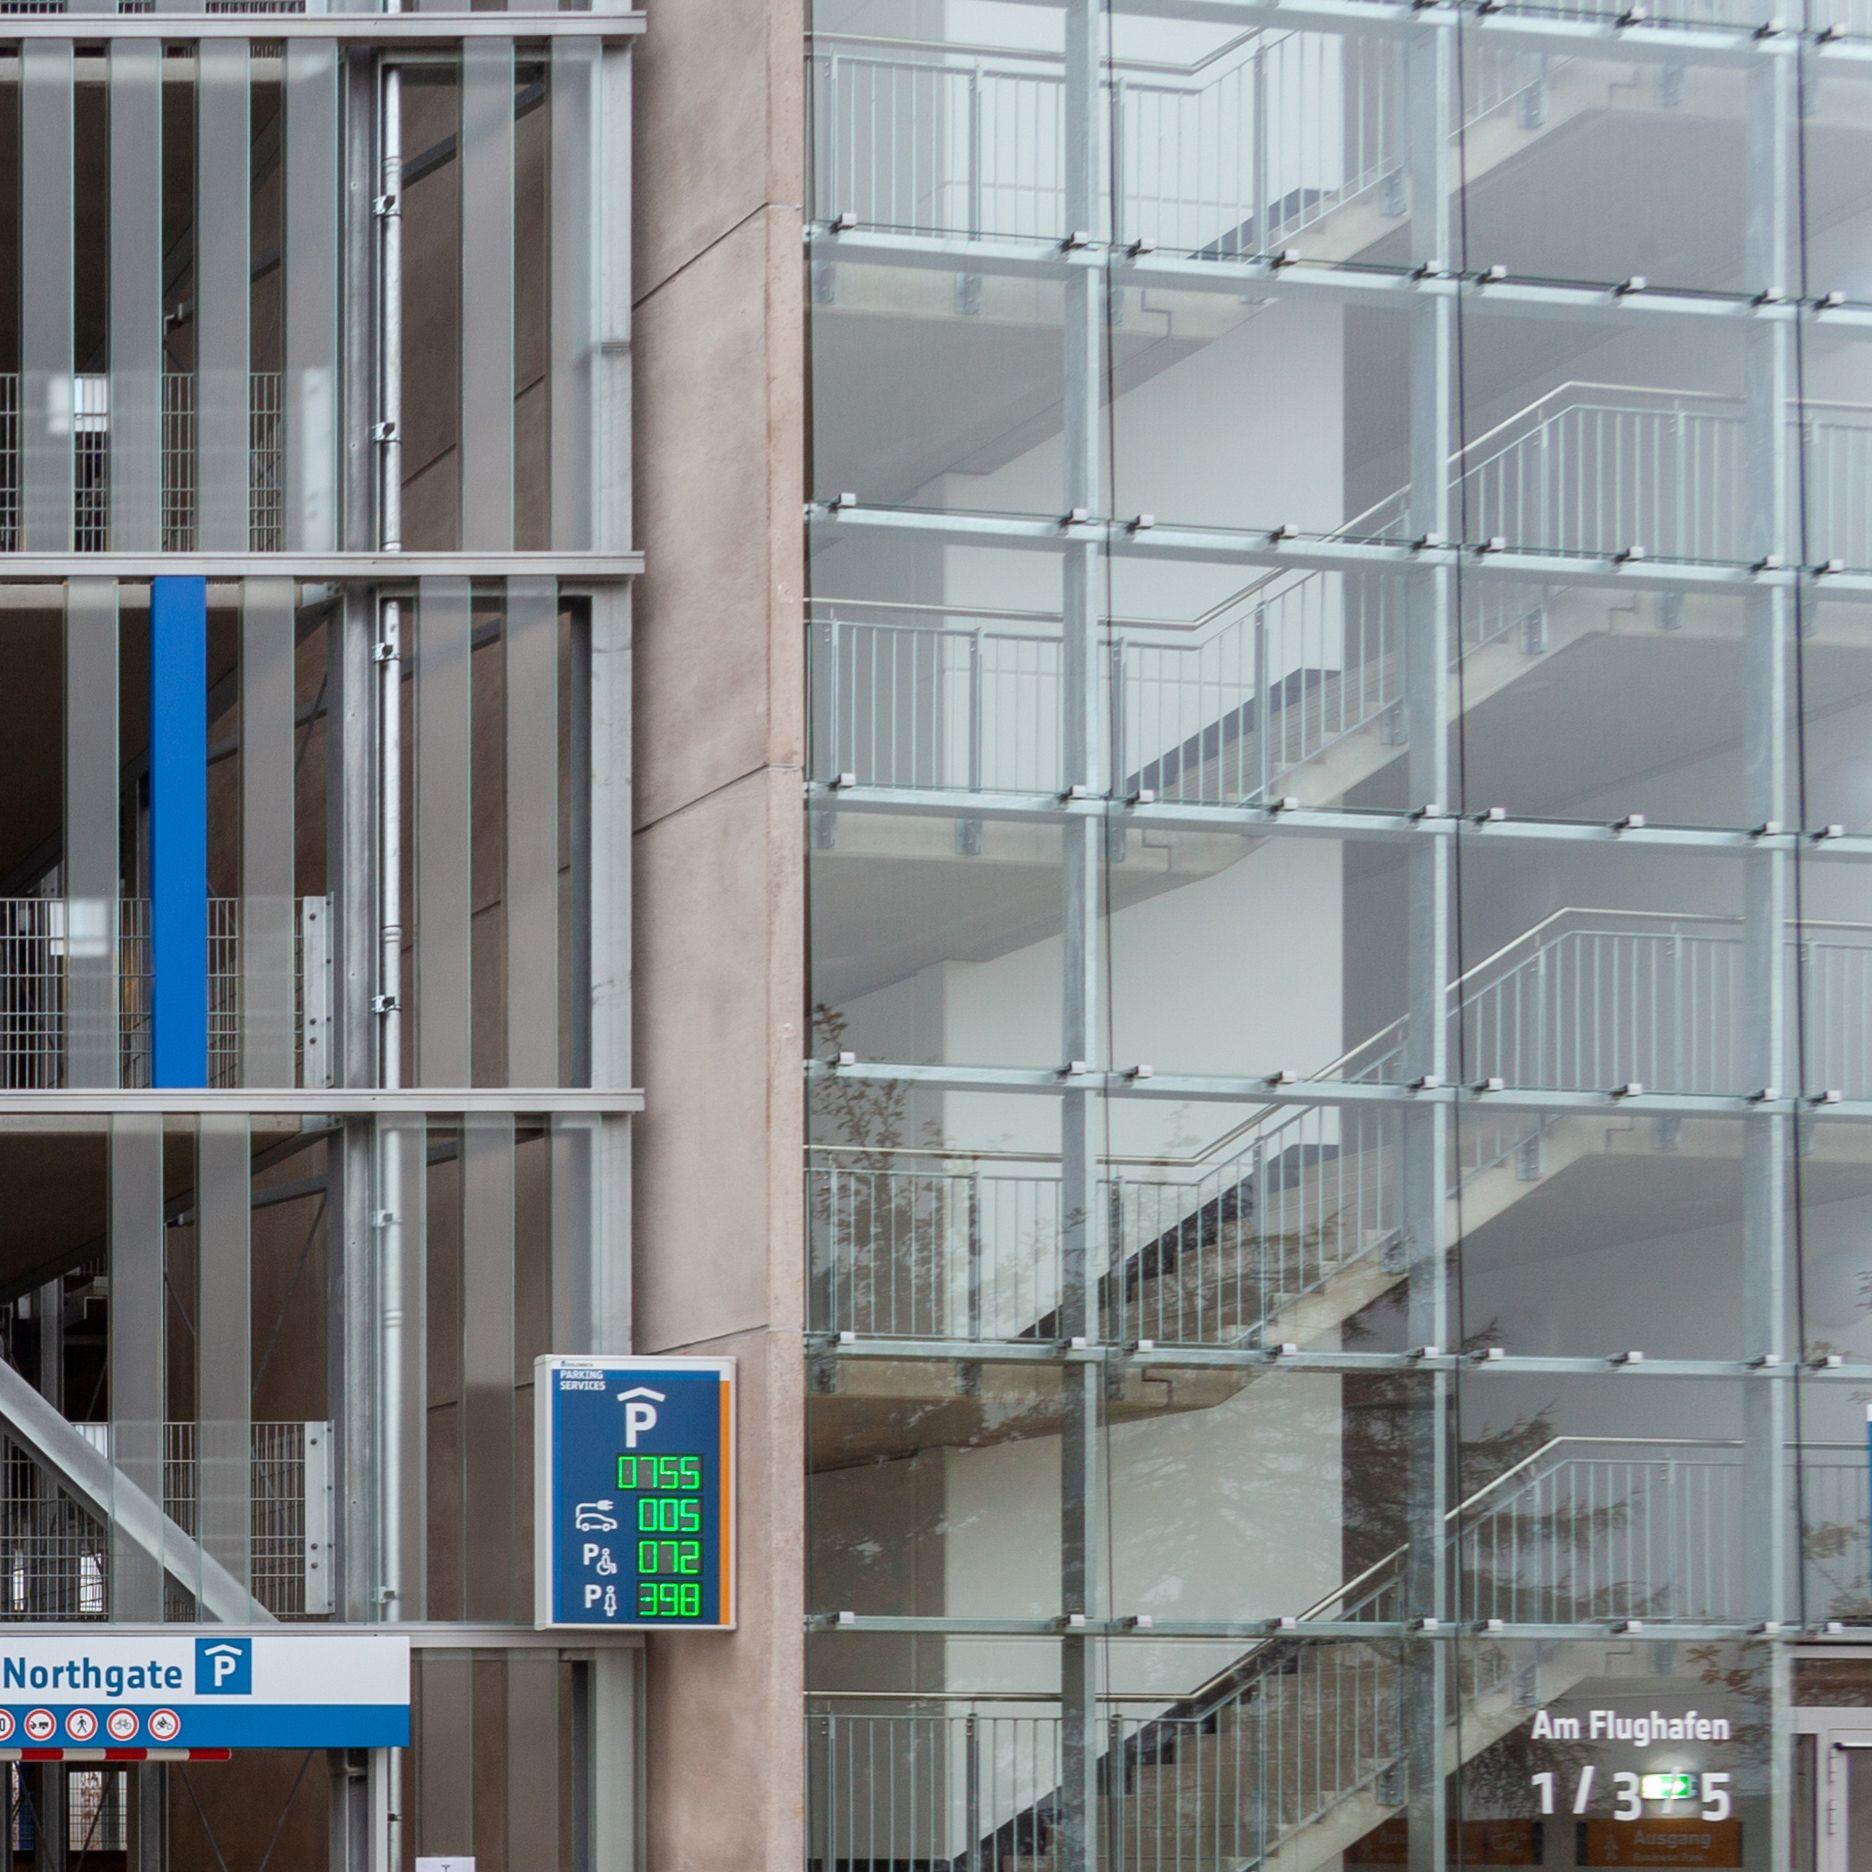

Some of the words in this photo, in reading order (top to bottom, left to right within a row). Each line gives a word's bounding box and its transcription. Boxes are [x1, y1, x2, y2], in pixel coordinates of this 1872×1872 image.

[560, 1370, 604, 1379] PARKING
[560, 1381, 606, 1391] SERVICES
[625, 1402, 658, 1449] P
[617, 1456, 701, 1490] 0755
[638, 1498, 701, 1532] 005
[638, 1541, 701, 1575] 072
[640, 1583, 701, 1617] 398
[3, 1657, 183, 1698] Northgate
[1531, 1710, 1580, 1740] Am
[1589, 1710, 1731, 1748] Flughafen
[1531, 1772, 1554, 1815] 1
[1612, 1771, 1644, 1822] 3
[1700, 1771, 1732, 1822] 5
[1634, 1830, 1712, 1849] Ausgang
